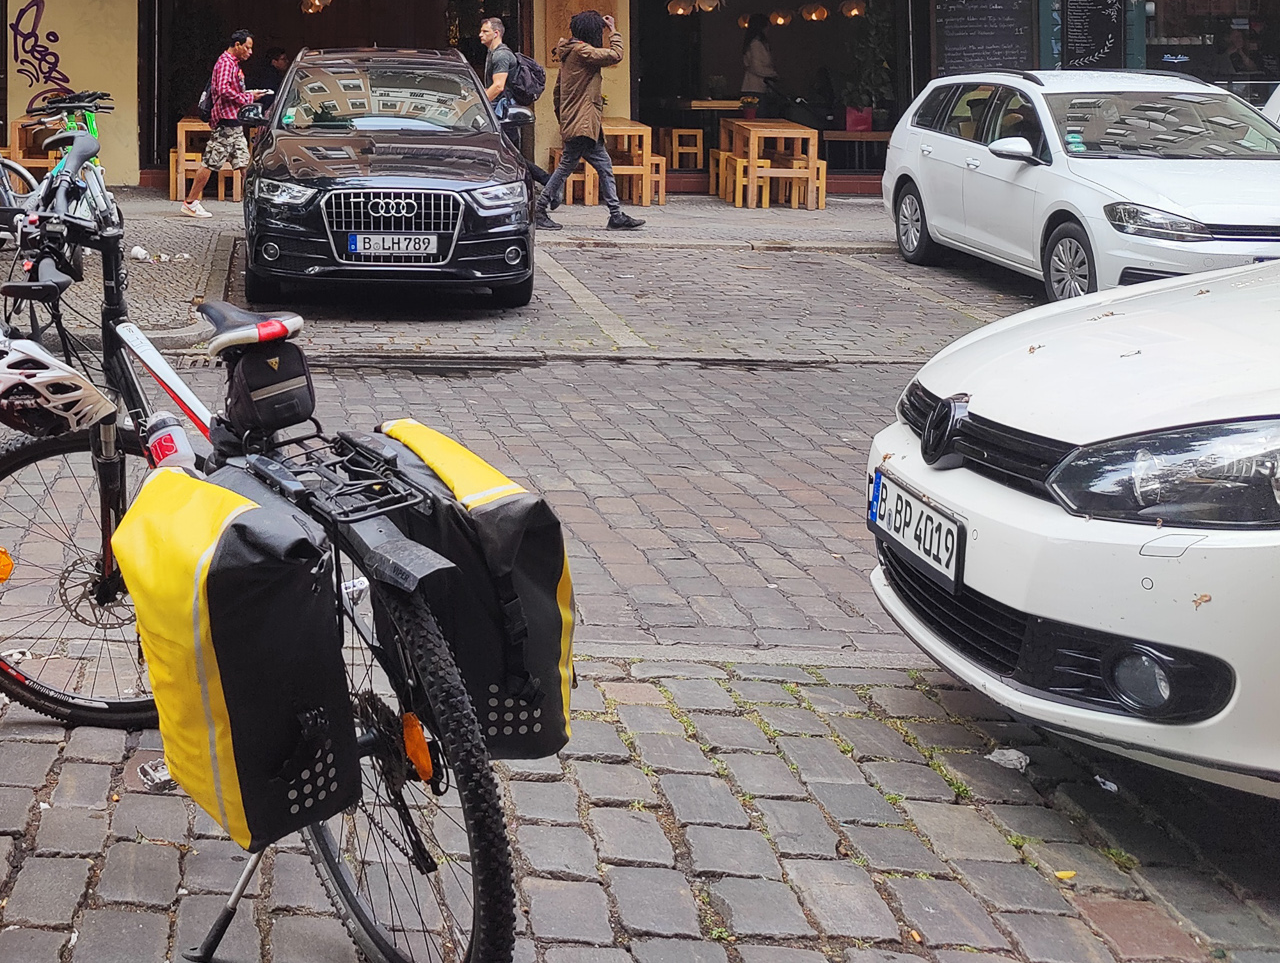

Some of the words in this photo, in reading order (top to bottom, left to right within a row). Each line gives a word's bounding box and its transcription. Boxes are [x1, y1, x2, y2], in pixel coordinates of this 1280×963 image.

[363, 237, 372, 250] B
[382, 237, 400, 250] LH
[404, 237, 431, 251] 789
[878, 481, 888, 521] B
[893, 493, 913, 539] BP
[914, 509, 955, 570] 4019
[392, 565, 410, 583] VIPER
